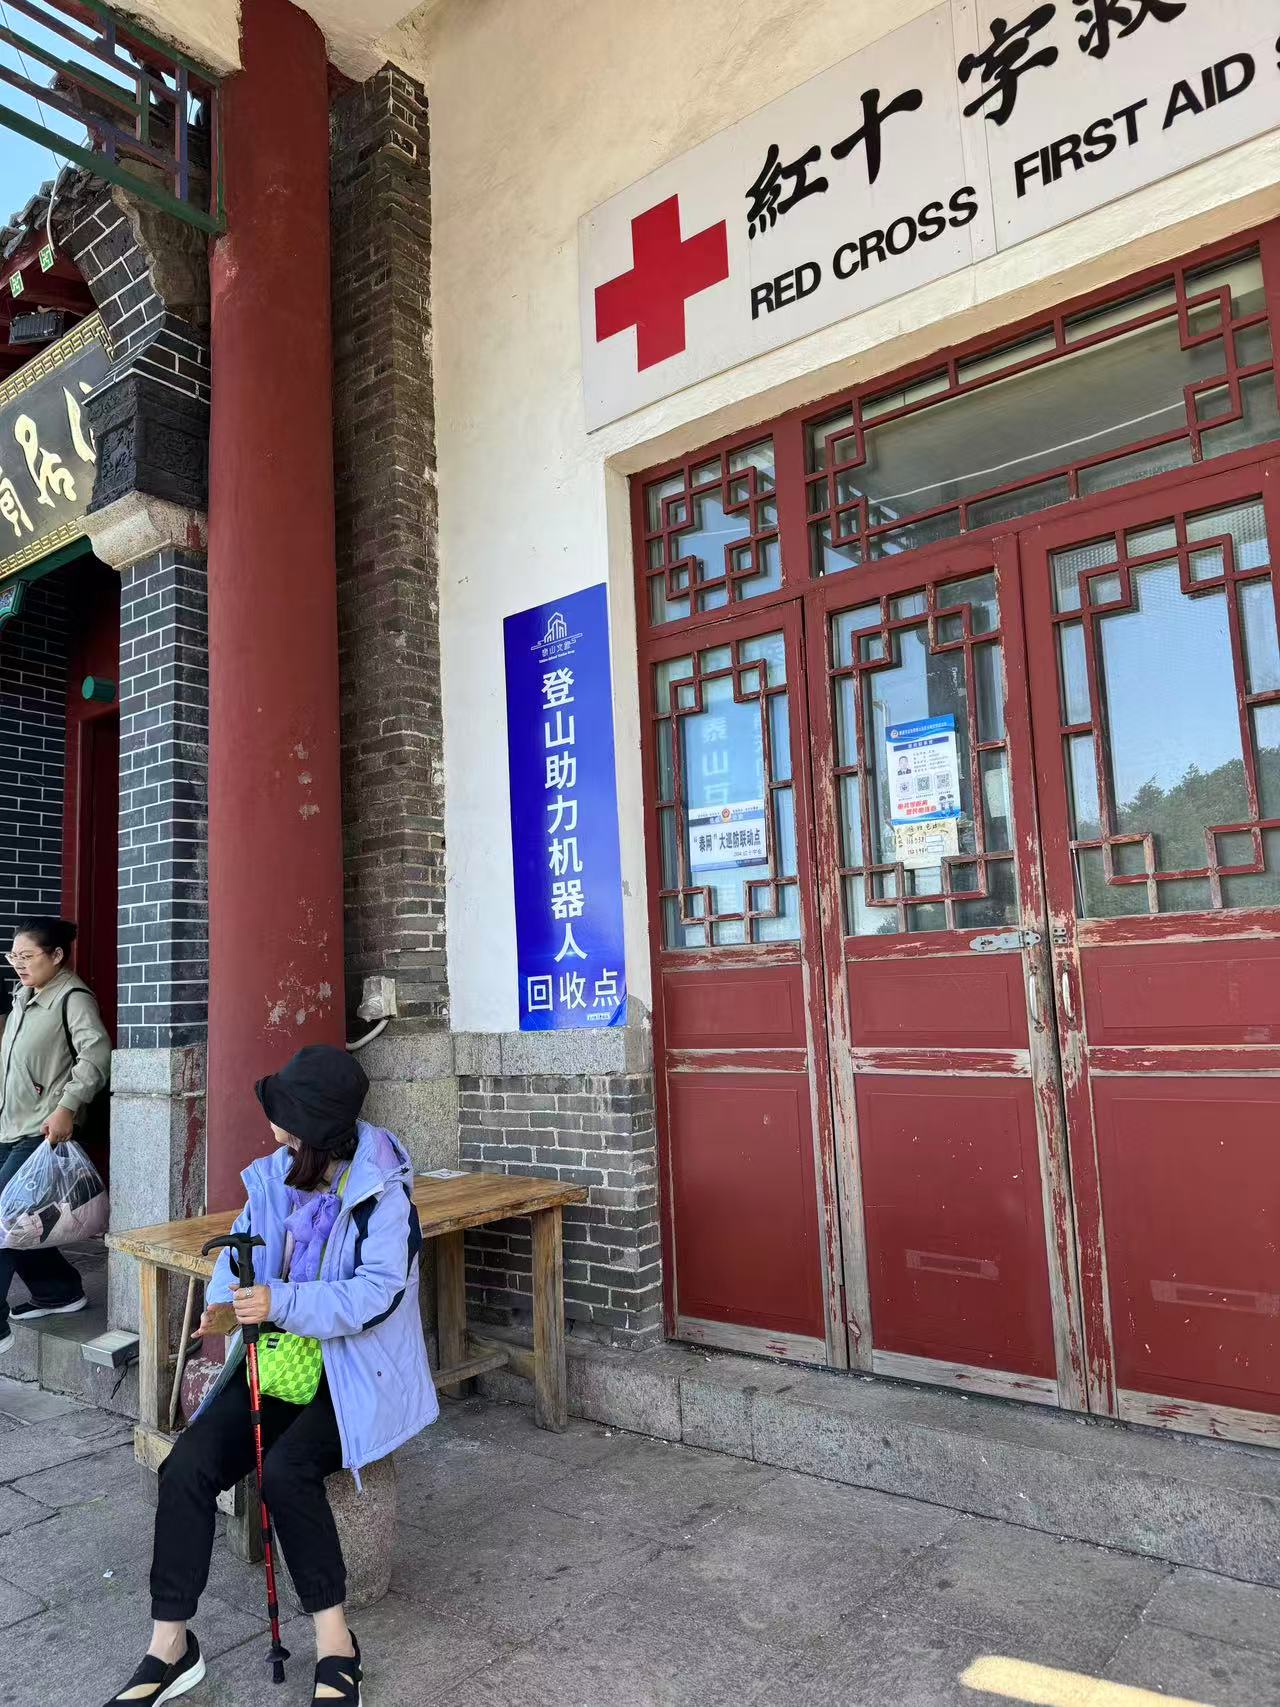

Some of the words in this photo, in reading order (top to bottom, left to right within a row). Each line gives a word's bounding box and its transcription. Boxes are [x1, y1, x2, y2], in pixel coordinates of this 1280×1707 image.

[750, 261, 822, 321] RED
[832, 185, 979, 280] CROSS
[1013, 97, 1148, 199] FIRST
[1161, 52, 1256, 131] AID
[541, 667, 588, 963] 登山助力机器人
[526, 967, 622, 1013] 回收点
